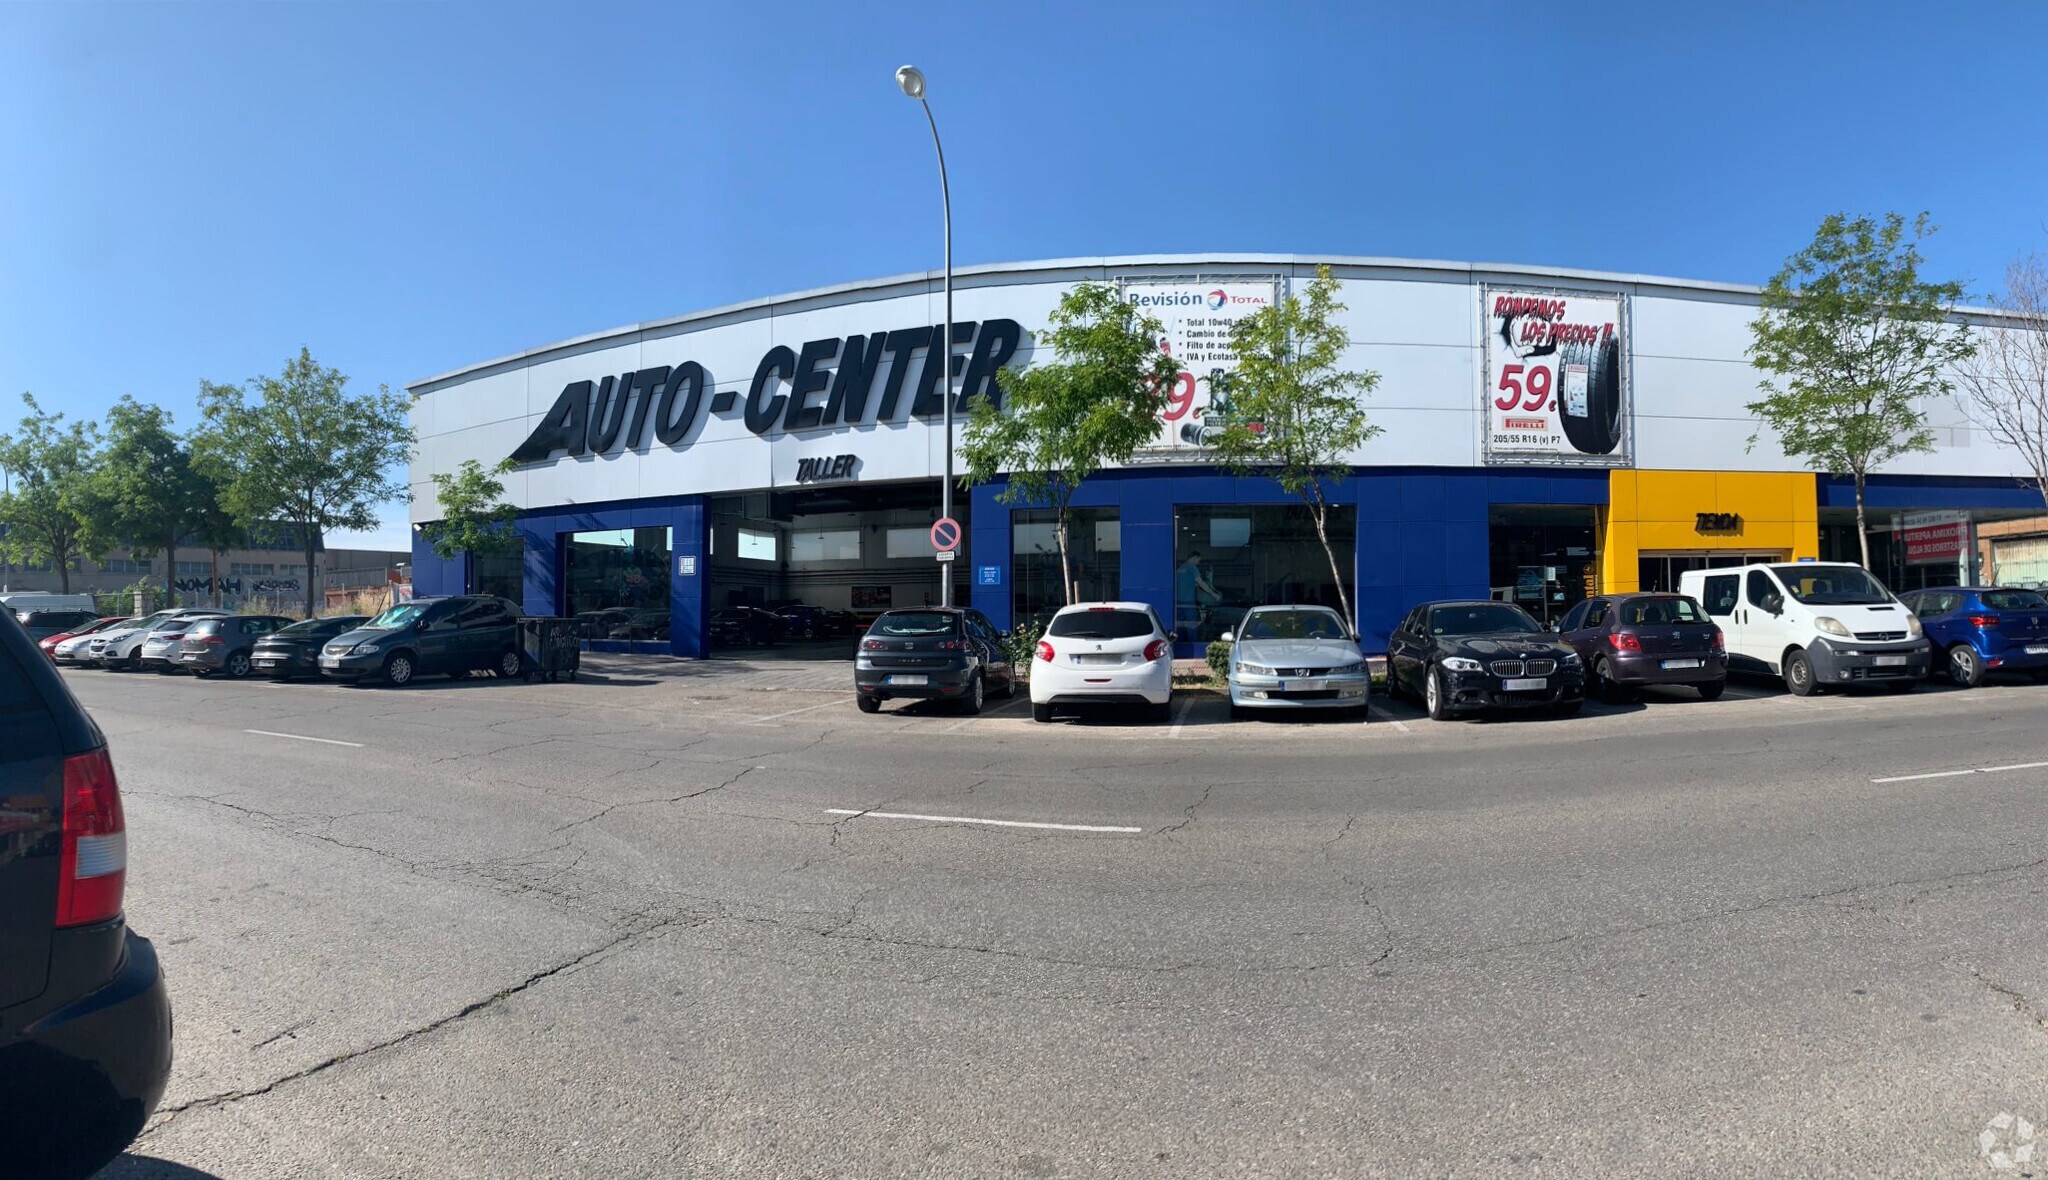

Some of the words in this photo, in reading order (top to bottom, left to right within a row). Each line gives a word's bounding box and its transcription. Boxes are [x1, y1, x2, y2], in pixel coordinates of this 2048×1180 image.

[1129, 290, 1203, 307] Revisión
[1493, 296, 1567, 320] ROMPEMOS
[1186, 318, 1205, 327] Total
[1208, 318, 1233, 327] 10w40
[1186, 329, 1215, 338] Cambio
[1217, 329, 1226, 338] de
[1520, 322, 1547, 343] LOS
[1548, 324, 1598, 347] PRECIOS
[1186, 341, 1204, 350] Filto
[1206, 341, 1216, 350] de
[1186, 352, 1199, 361] IVA
[1201, 354, 1205, 362] y
[1208, 352, 1238, 361] Ecotasa
[1505, 418, 1545, 429] PIRELLI
[1493, 434, 1520, 444] 205/55
[1522, 434, 1538, 444] R16
[1551, 436, 1561, 444] P7
[796, 454, 857, 483] TALLER
